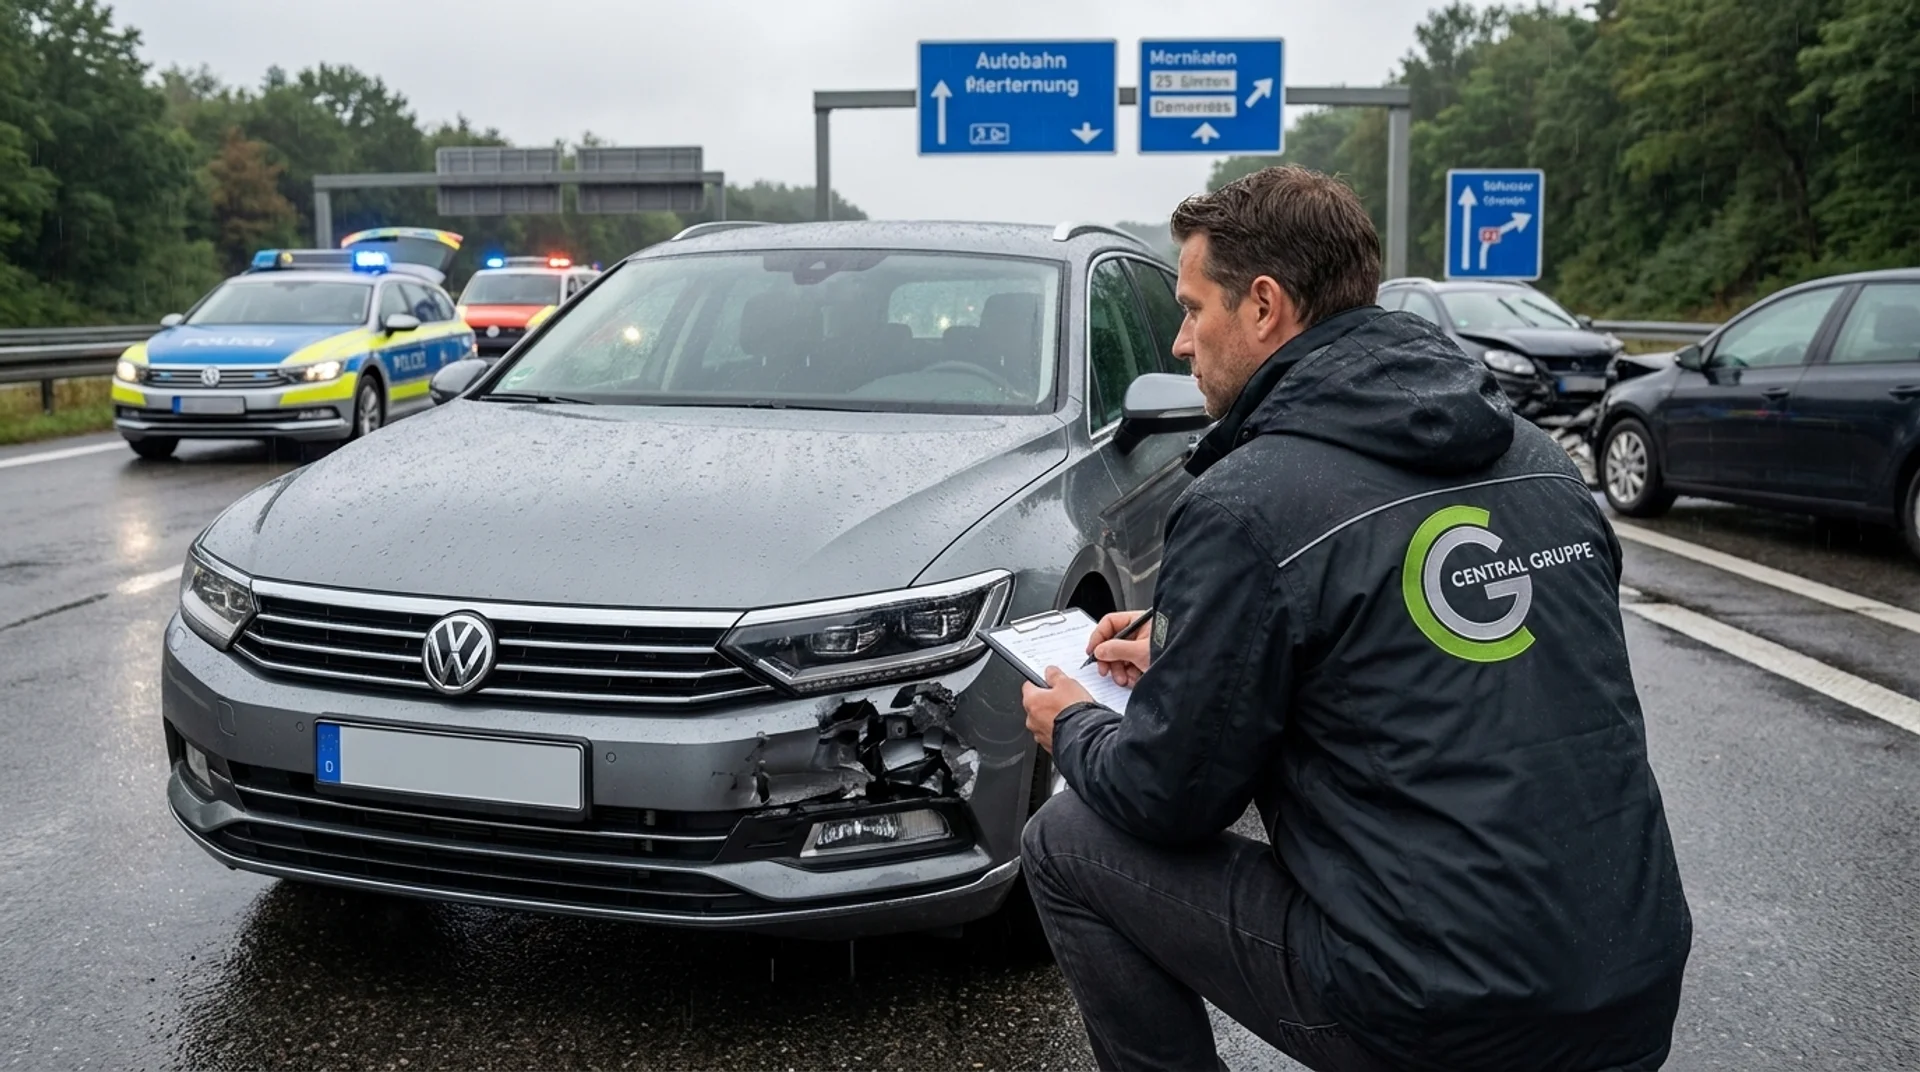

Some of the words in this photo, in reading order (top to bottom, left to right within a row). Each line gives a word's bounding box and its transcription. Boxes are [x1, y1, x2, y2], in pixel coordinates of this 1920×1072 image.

[975, 51, 1068, 70] Autobahn
[1451, 556, 1529, 588] CENTRAL
[1529, 541, 1594, 569] GRUPPE
